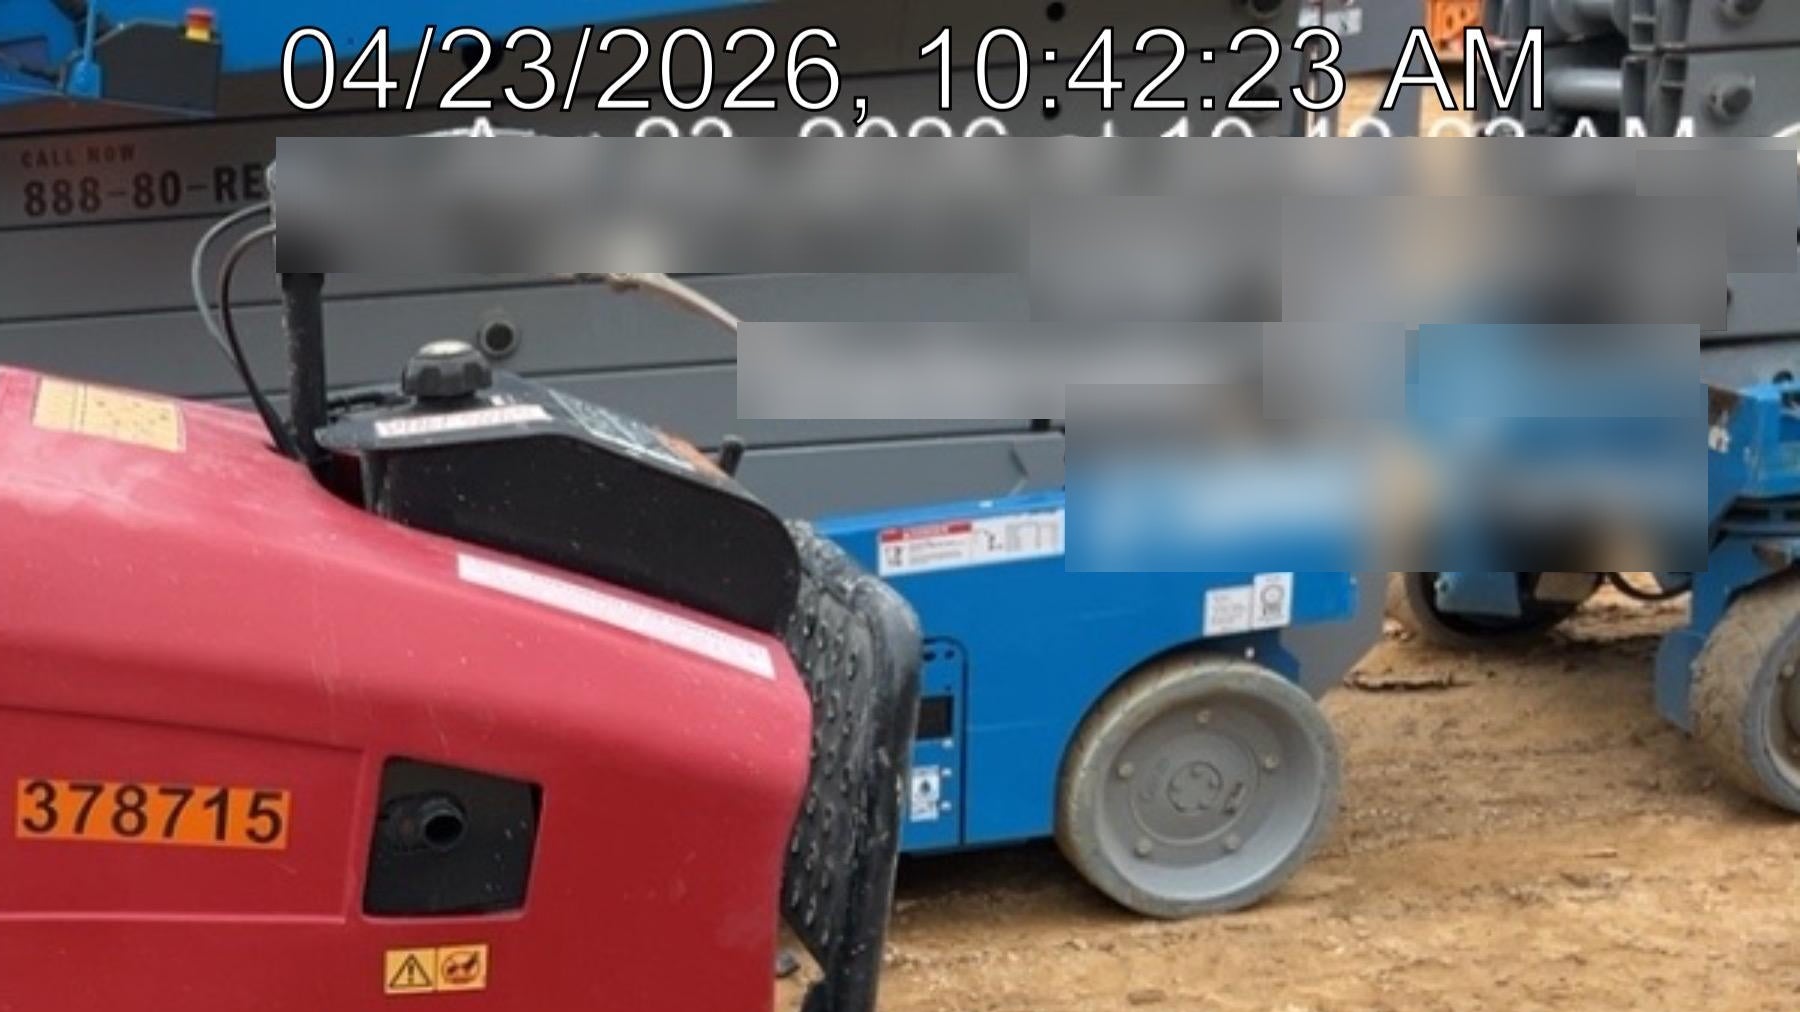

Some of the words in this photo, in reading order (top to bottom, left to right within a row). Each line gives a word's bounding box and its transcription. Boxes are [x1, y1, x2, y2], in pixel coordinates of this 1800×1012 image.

[20, 150, 75, 169] CALL
[86, 144, 136, 164] NOW
[22, 779, 284, 844] 378715
